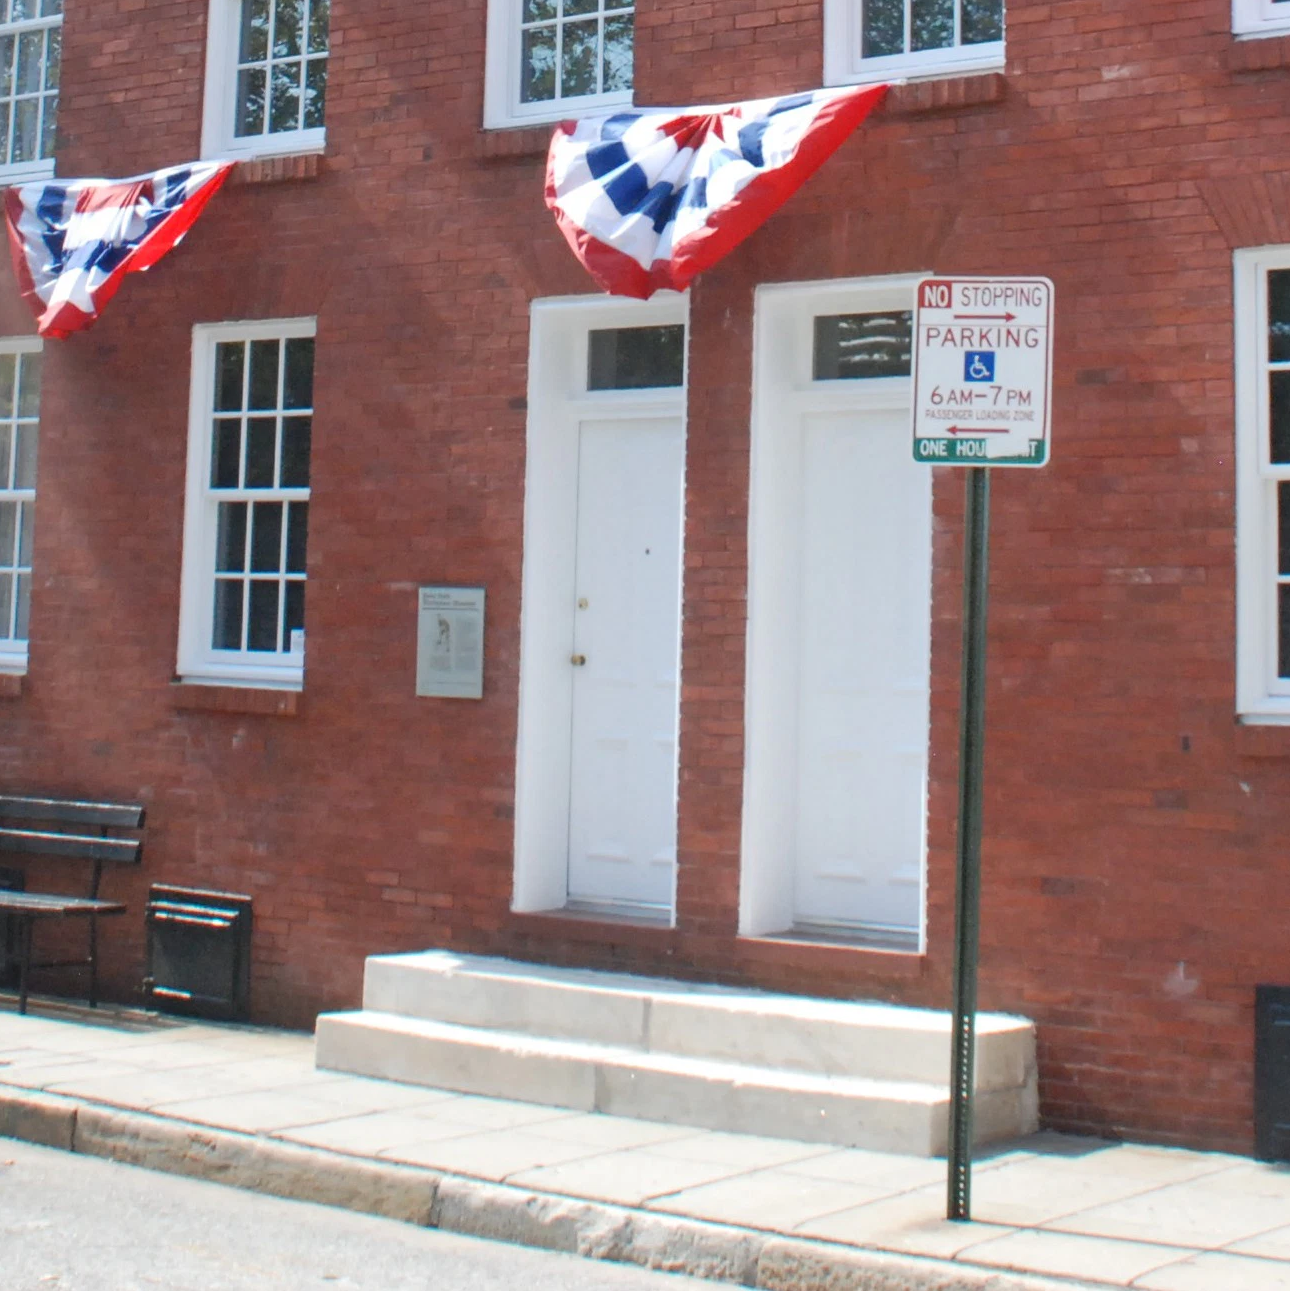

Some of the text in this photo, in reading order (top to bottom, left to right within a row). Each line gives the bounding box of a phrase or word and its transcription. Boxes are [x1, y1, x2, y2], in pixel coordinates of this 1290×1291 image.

[923, 284, 1043, 308] NO STOPPING
[925, 326, 1040, 349] PARKING
[924, 408, 1036, 422] PASSENGER LOADING ZONE
[919, 438, 949, 457] ONE
[955, 439, 987, 458] HOU
